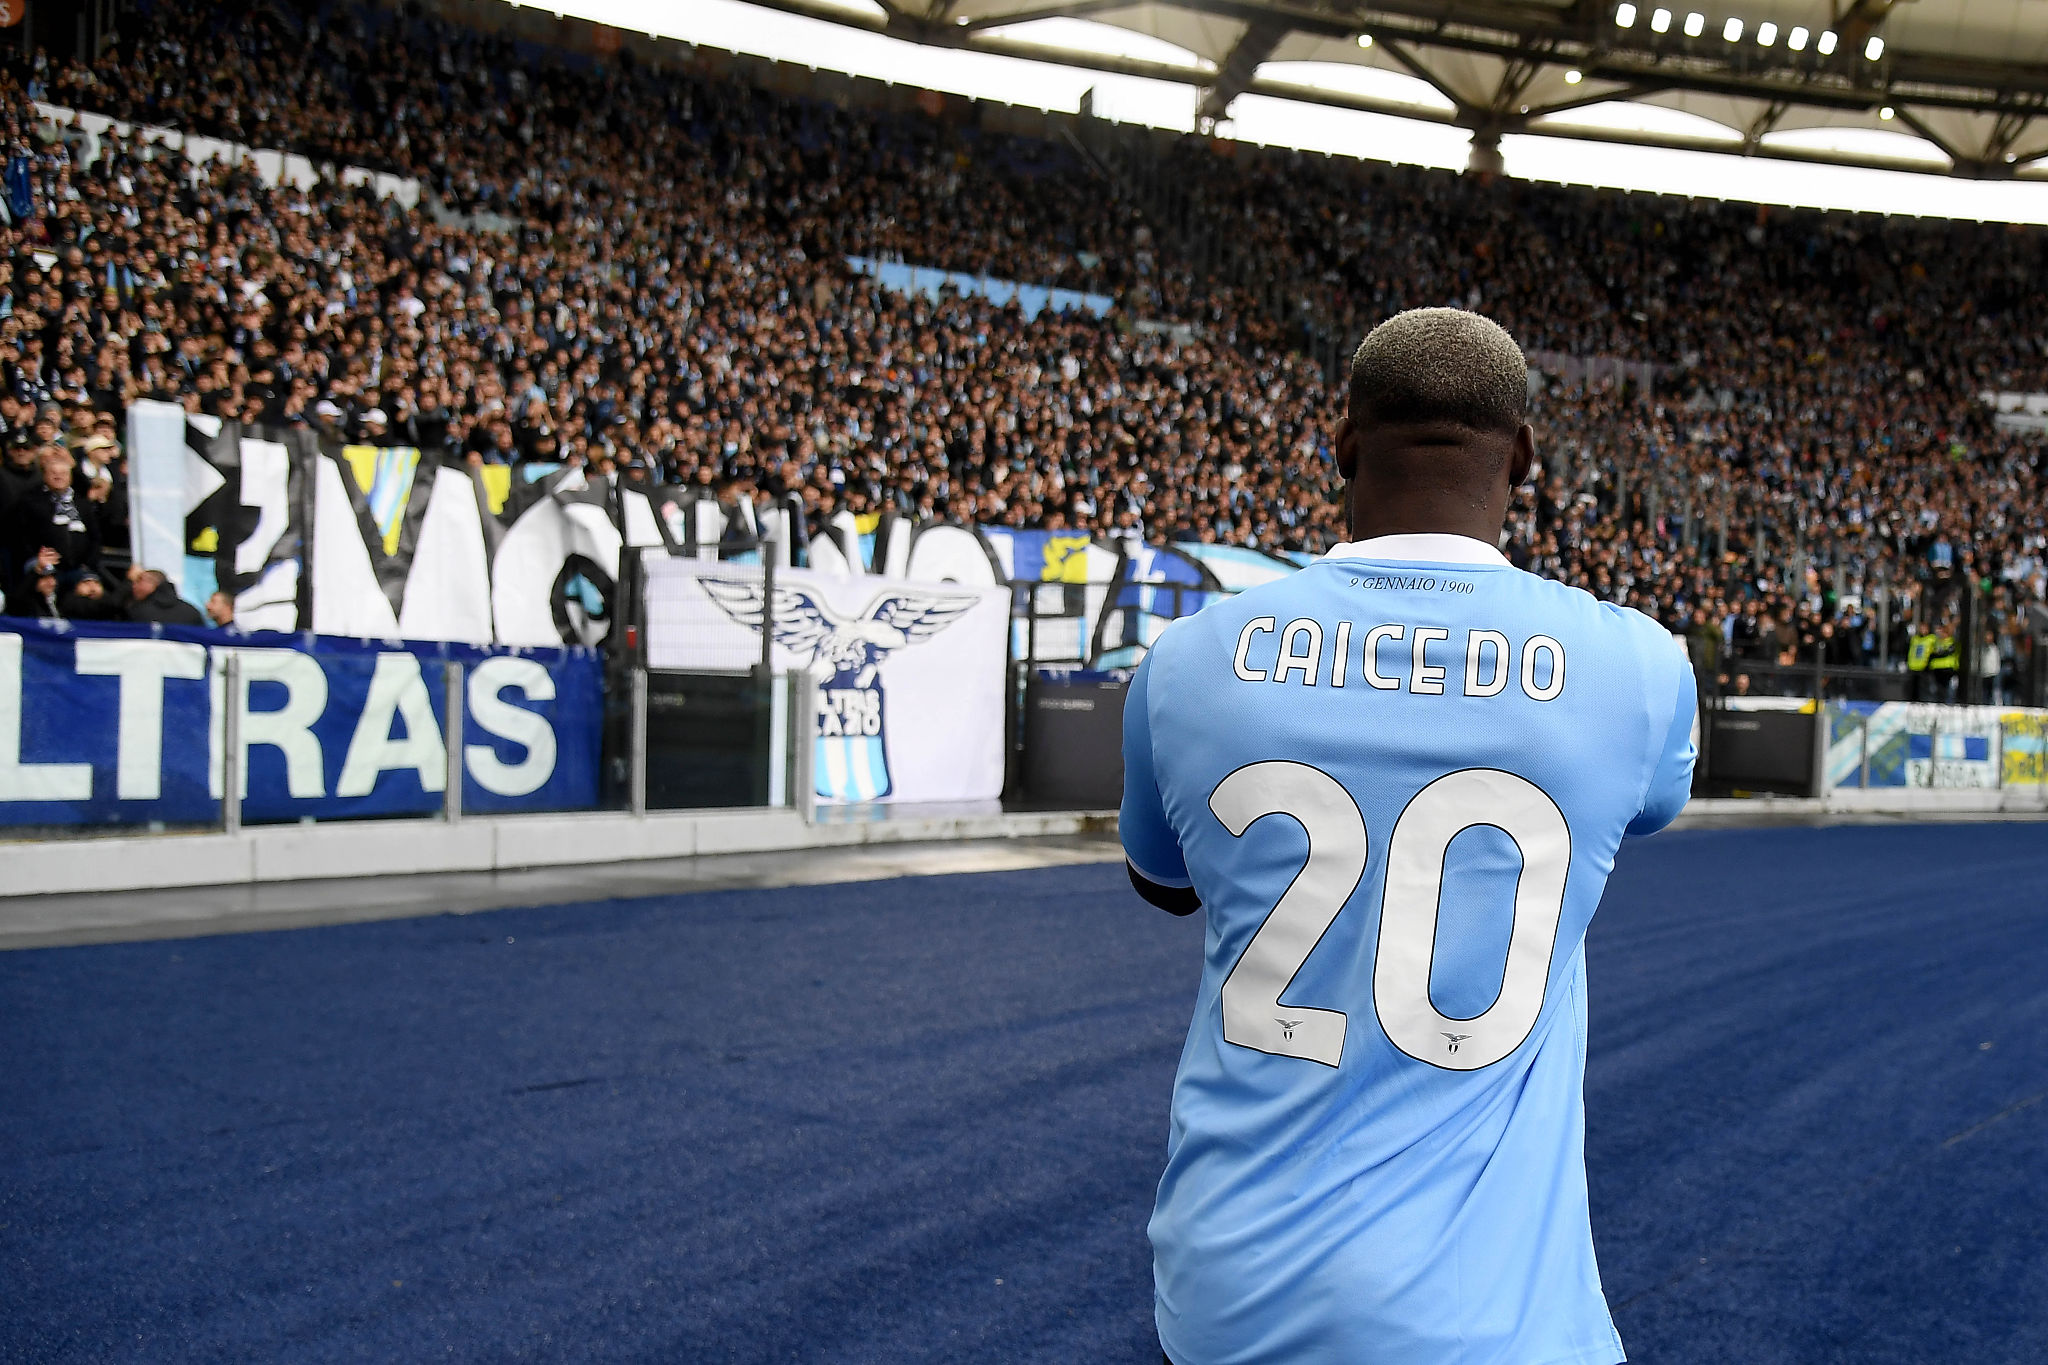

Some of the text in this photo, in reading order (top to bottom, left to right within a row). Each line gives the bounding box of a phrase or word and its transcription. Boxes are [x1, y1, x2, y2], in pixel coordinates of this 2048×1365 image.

[1348, 577, 1475, 595] 9 GENNAIO 1900
[1233, 616, 1566, 702] CAICEDO
[1208, 759, 1572, 1071] 20
